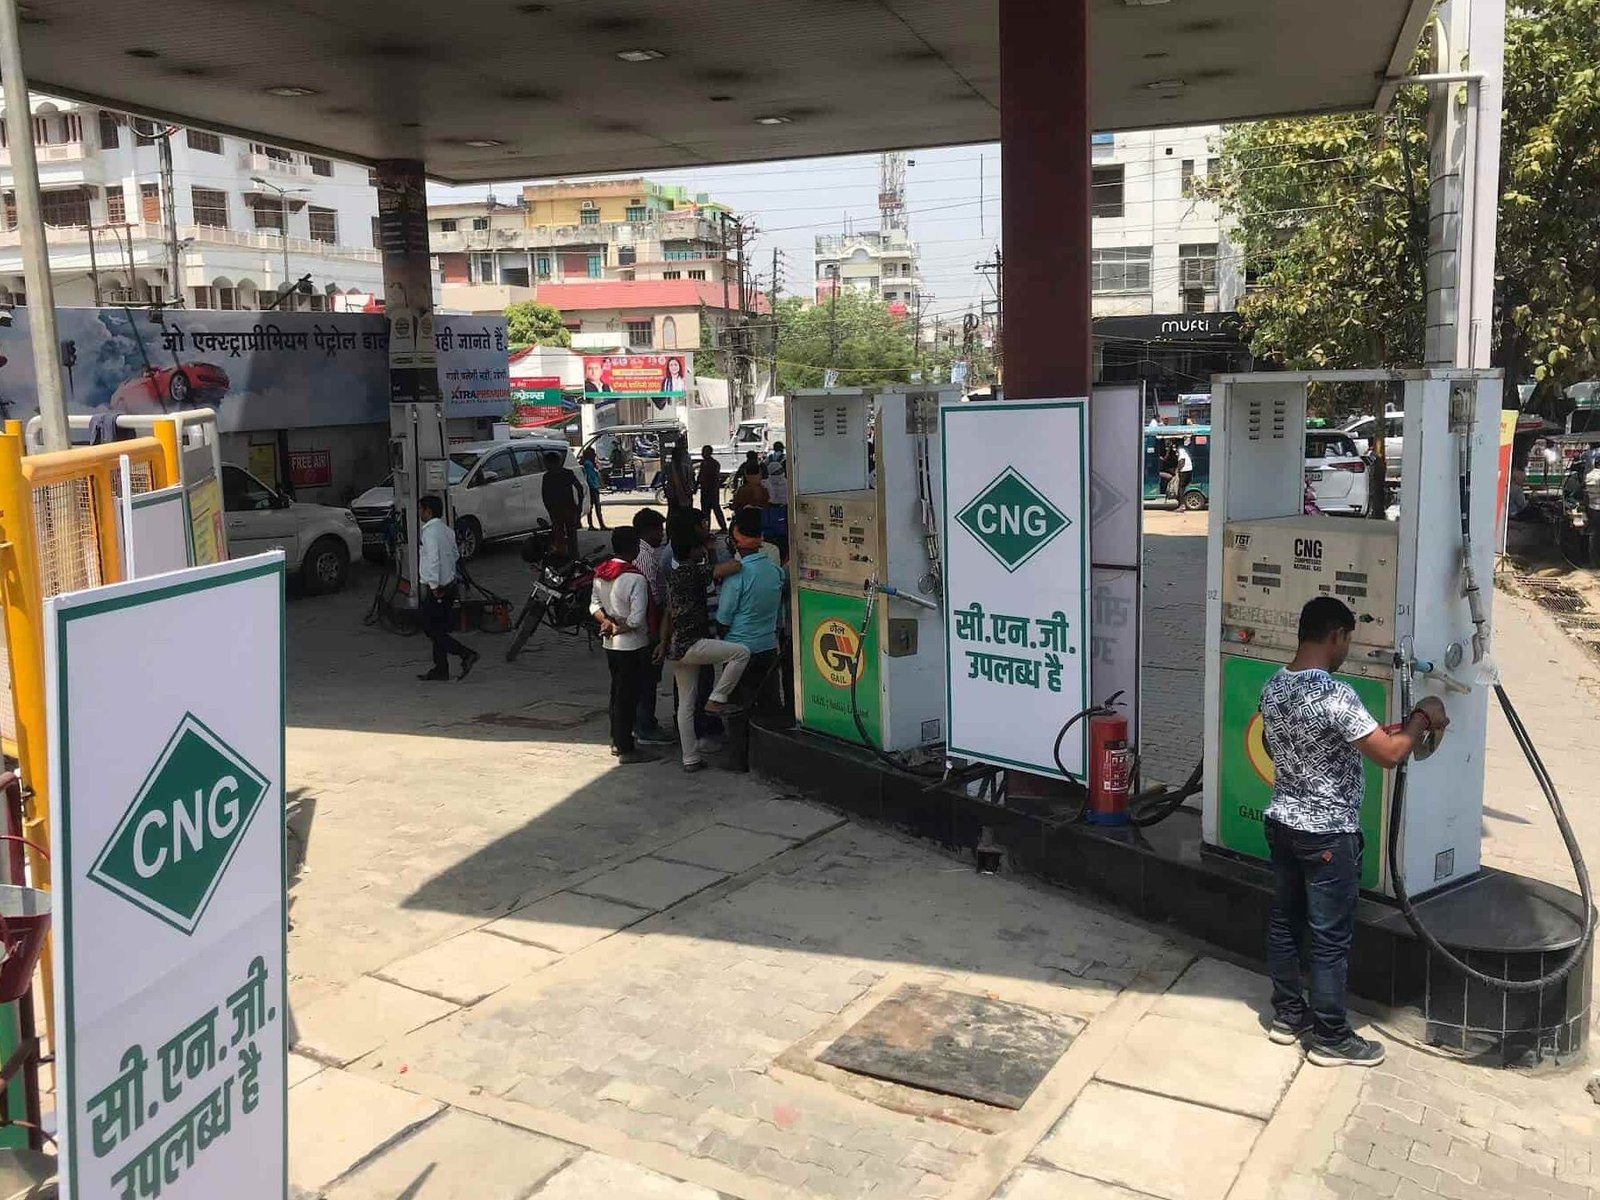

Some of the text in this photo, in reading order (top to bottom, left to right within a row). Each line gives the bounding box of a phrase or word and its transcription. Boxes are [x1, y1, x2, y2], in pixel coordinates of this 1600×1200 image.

[161, 324, 185, 352] जो
[191, 324, 308, 358] एक्स्ट्राप्रीमियम
[313, 324, 356, 358] पेट्रोल
[457, 327, 491, 350] जानते
[1161, 319, 1209, 333] mufti
[291, 455, 312, 470] FREE
[977, 504, 1046, 536] CNG
[1294, 538, 1323, 559] CNG
[953, 602, 1076, 653] सी.एन.जी.
[830, 673, 846, 684] GAIL
[965, 650, 1064, 692] उपलब्ध है
[132, 775, 241, 879] CNG
[86, 955, 276, 1159] सी.एन.जी.
[111, 1041, 262, 1200] उपलब्ध है
